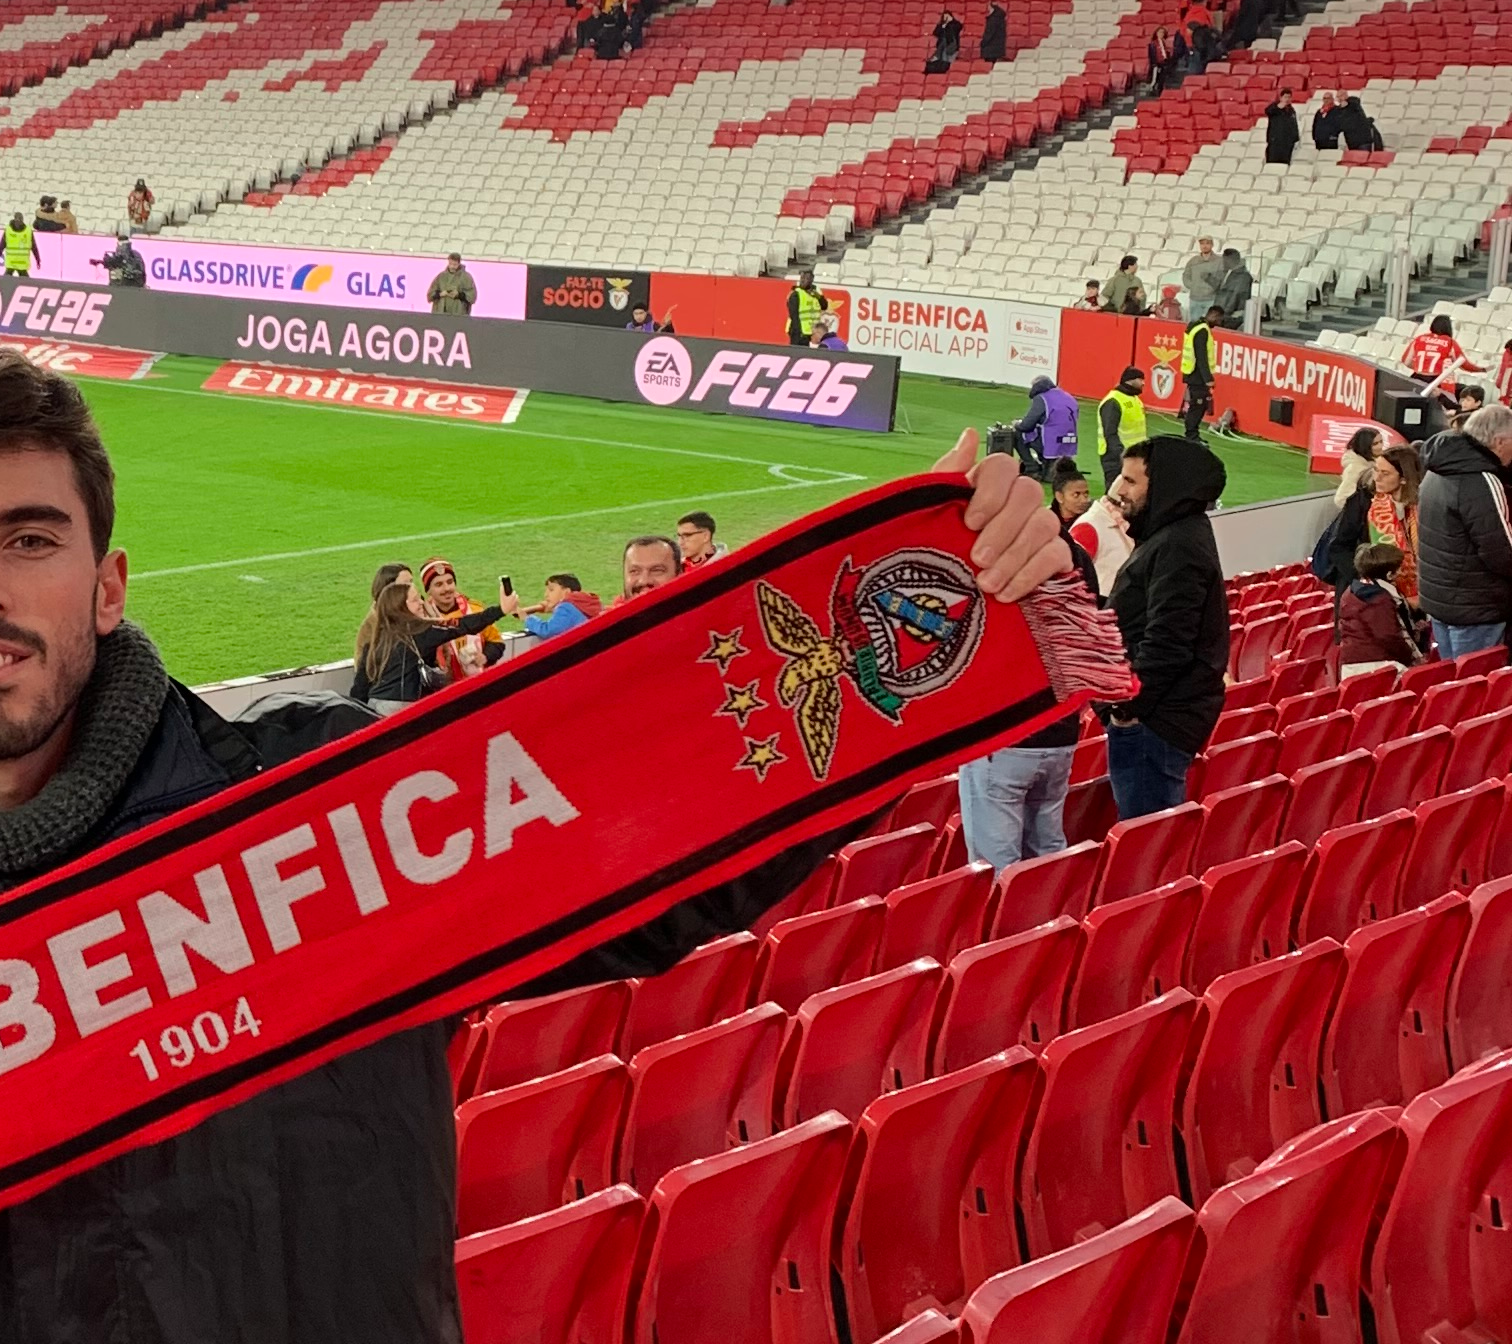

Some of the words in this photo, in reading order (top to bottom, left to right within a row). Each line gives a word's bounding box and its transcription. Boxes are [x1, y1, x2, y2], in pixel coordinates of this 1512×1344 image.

[151, 257, 285, 289] GLASSDRIVE
[346, 271, 406, 299] GLAS
[566, 277, 604, 289] FAZ-TE
[1, 285, 112, 336] FC26
[543, 284, 604, 309] SÓCIO
[857, 297, 882, 322] SL
[888, 300, 989, 333] BENFICA
[237, 314, 332, 356] JOGA
[338, 323, 472, 369] AGORA
[856, 325, 943, 354] OFFICIAL
[947, 335, 989, 359] APP
[646, 352, 680, 375] EA
[1417, 350, 1441, 373] 17
[228, 367, 487, 415] Emirates
[643, 374, 681, 388] SPORTS
[689, 350, 874, 417] FC26
[128, 996, 263, 1082] 1904
